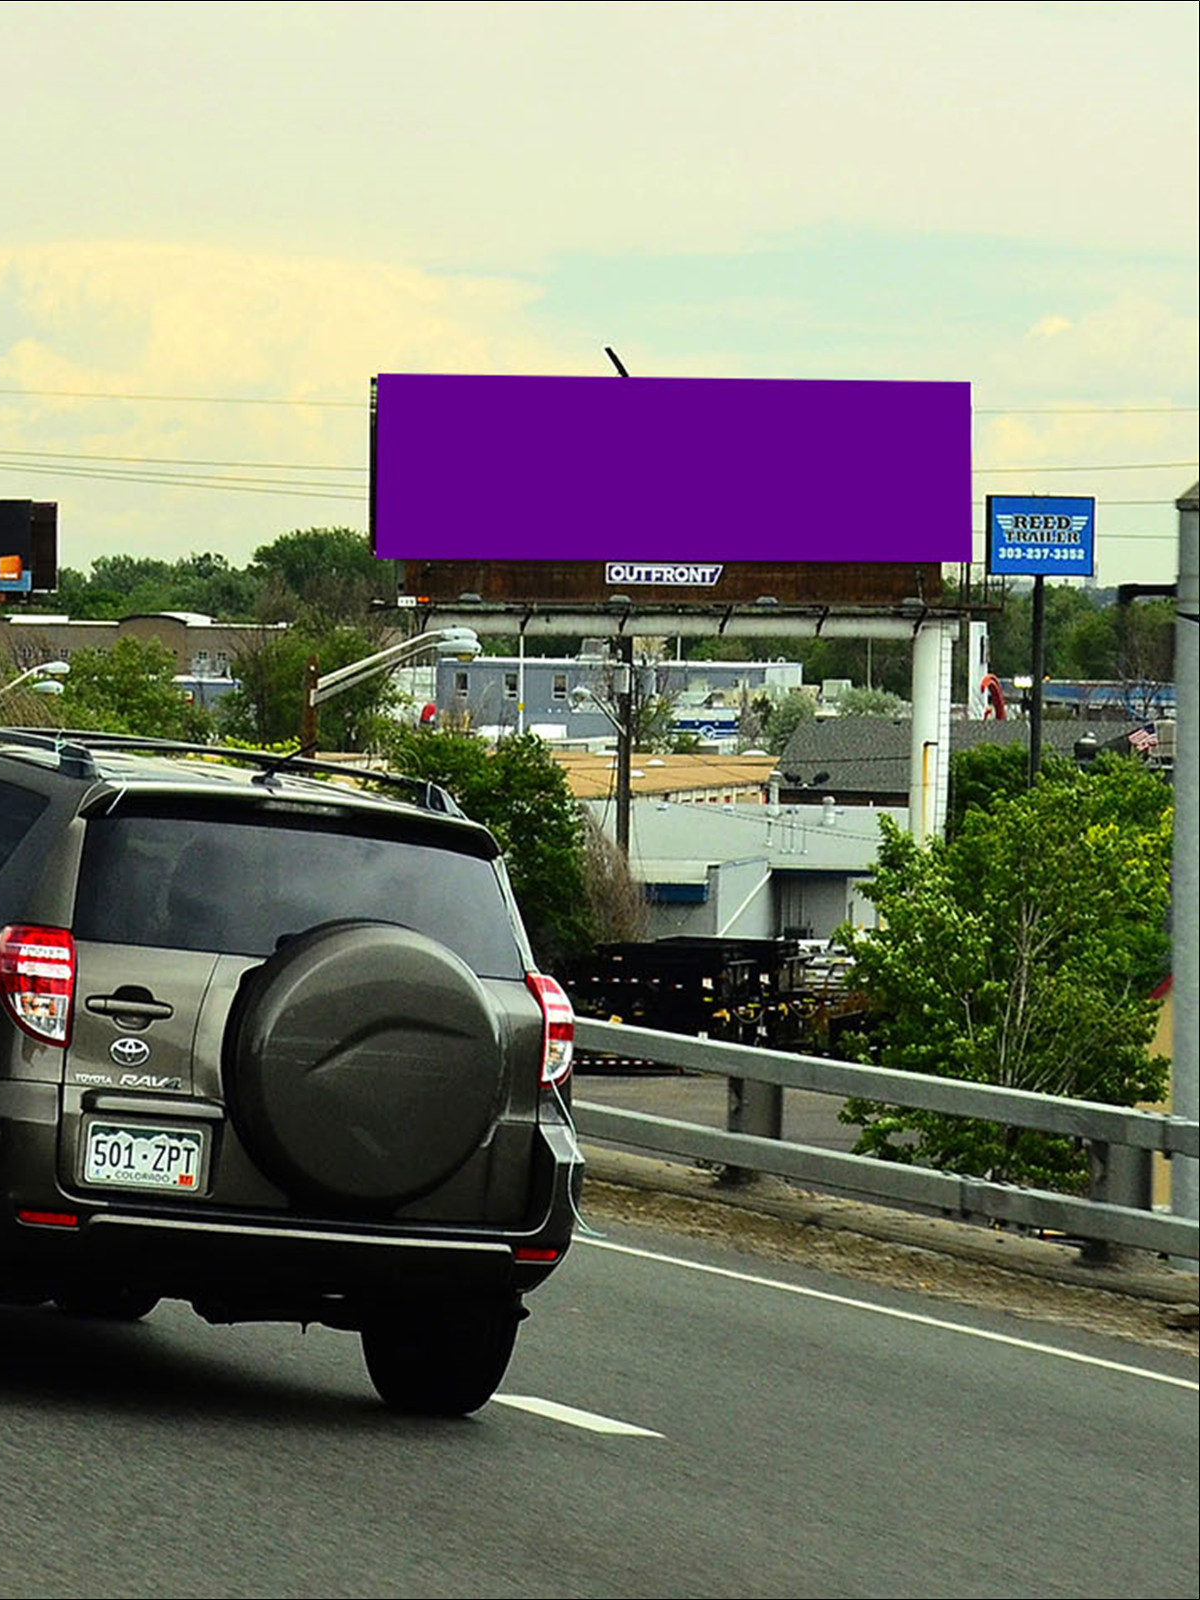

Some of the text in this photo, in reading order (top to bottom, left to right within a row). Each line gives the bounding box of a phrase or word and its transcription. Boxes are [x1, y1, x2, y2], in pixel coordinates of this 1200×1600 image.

[1013, 514, 1072, 530] REED
[1005, 530, 1080, 544] TRAILER
[610, 565, 716, 583] OUTFRONT
[75, 1073, 182, 1090] TOYOTA RAV4
[115, 1170, 170, 1183] COLORADO
